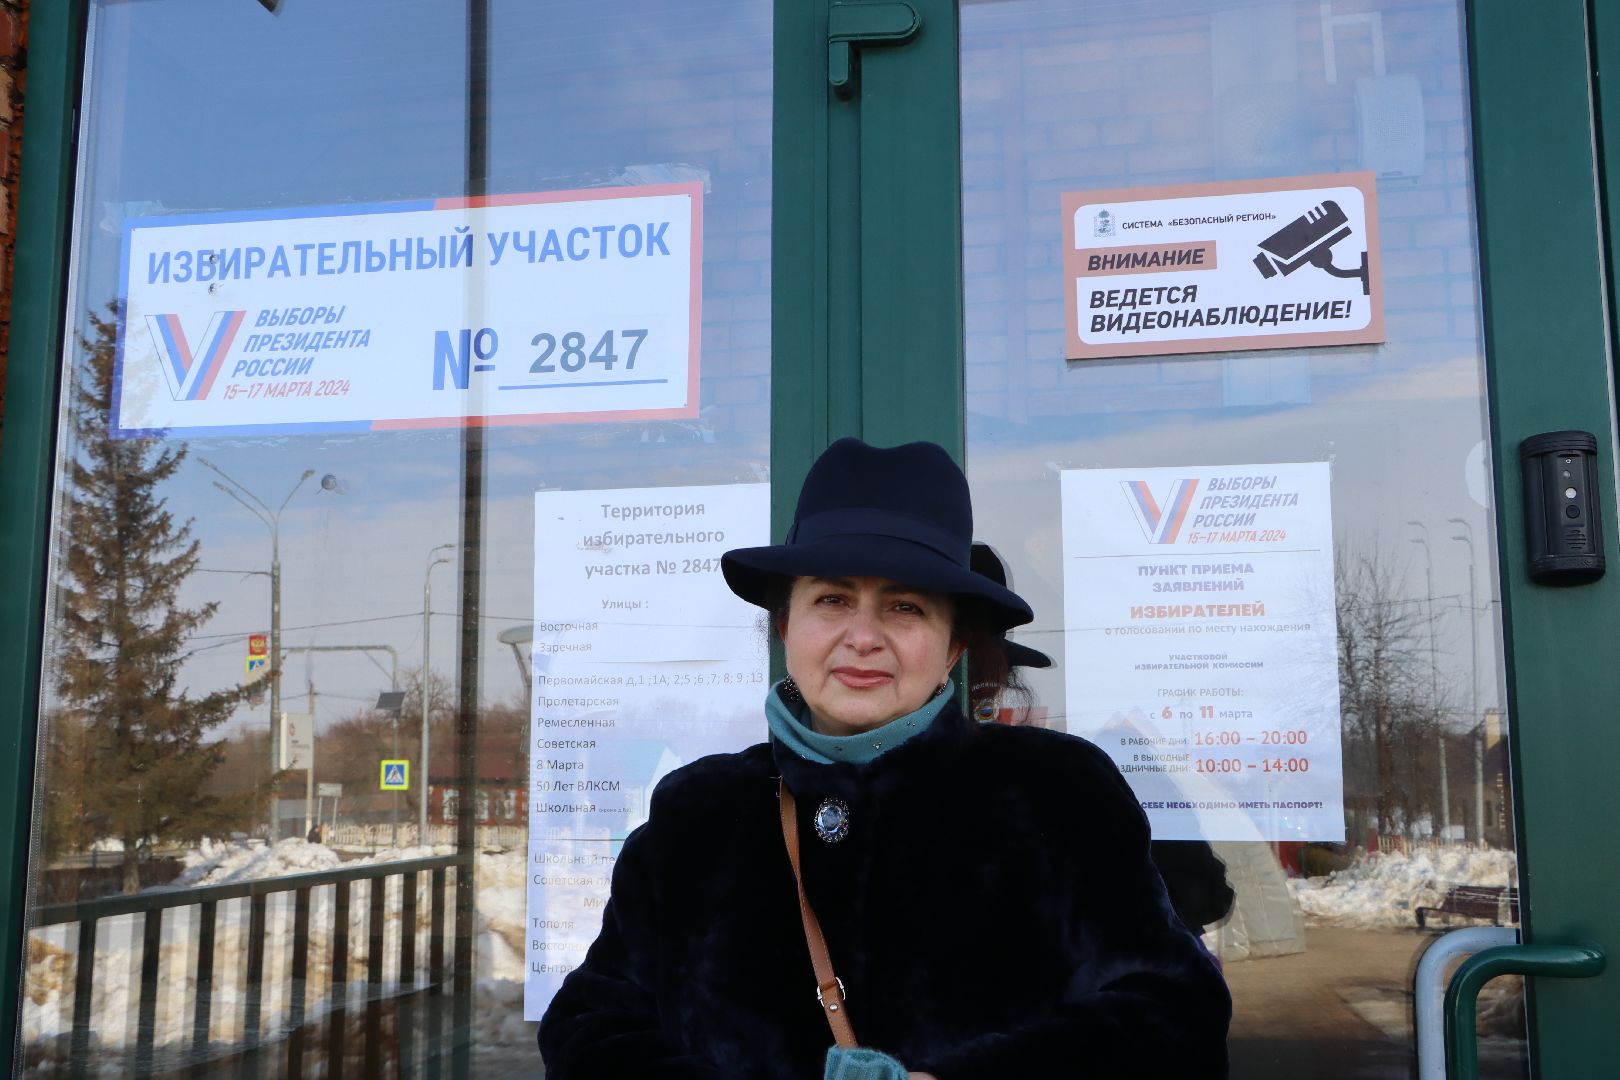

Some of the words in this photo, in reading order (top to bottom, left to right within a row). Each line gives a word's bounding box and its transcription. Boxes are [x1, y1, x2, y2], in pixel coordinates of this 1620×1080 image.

[1122, 219, 1163, 230] СИСТЕМА
[1168, 213, 1233, 227] «БЕЗОПАСНЫЙ
[1236, 212, 1276, 223] РЕГИОН»
[147, 226, 474, 284] ИЗБИРАТЕЛЬНЫЙ
[487, 221, 671, 266] УЧАСТОК
[1087, 248, 1206, 271] ВНИМАНИЕ
[1089, 285, 1198, 311] ВЕДЕТСЯ
[254, 305, 346, 327] ВЫБОРЫ
[1090, 300, 1353, 334] ВИДЕОНАБЛЮДЕНИЕ!
[243, 329, 371, 353] ПРЕЗИДЕНТА
[432, 327, 498, 390] №
[528, 328, 648, 374] 2847
[232, 357, 314, 378] РОССИИ
[266, 381, 312, 398] МАРТА
[314, 379, 351, 396] 2024
[1206, 476, 1277, 491] ВЫБОРЫ
[1199, 493, 1299, 510] ПРЕЗИДЕНТА
[601, 503, 705, 521] Территория
[1193, 513, 1257, 528] РОССИИ
[583, 530, 725, 549] избирательного
[1219, 531, 1256, 543] МАРТА
[1259, 529, 1287, 541] 2024
[585, 564, 650, 579] участка
[656, 560, 677, 574] №
[682, 558, 720, 574] 2847
[1138, 565, 1187, 577] ПУНКТ
[1191, 563, 1255, 575] ПРИЕМА
[1152, 577, 1245, 593] ЗАЯВЛЕНИЙ
[601, 599, 642, 611] Улицы
[1130, 601, 1265, 619] ИЗБИРАТЕЛЕЙ
[540, 621, 598, 632] Восточная
[1114, 626, 1185, 636] голосовании
[1188, 626, 1202, 634] по
[1205, 625, 1237, 635] месту
[1240, 623, 1311, 633] нахождения
[540, 643, 592, 653] Заречная
[1168, 653, 1228, 661] УЧАСТКОВОЙ
[1134, 662, 1209, 670] ИЗБИРАТЕЛЬНОЙ
[1213, 661, 1263, 669] КОМИССИИ
[538, 675, 623, 686] Первомайская
[1157, 688, 1197, 697] ГРАФИК
[1199, 687, 1244, 697] РАБОТЫ:
[538, 696, 619, 707] Пролетарская
[1161, 706, 1172, 719] 6
[1180, 711, 1193, 719] по
[1199, 706, 1214, 719] 11
[1219, 710, 1253, 720] марта
[537, 718, 615, 728] Ремесленная
[537, 739, 596, 749] Советская
[1194, 731, 1240, 745] 16:00
[1261, 730, 1308, 745] 20:00
[1141, 754, 1190, 762] ВЫХОДНЫЕ
[1195, 758, 1242, 773] 10:00
[1262, 757, 1309, 772] 14:00
[537, 760, 543, 770] 8
[547, 760, 584, 771] Марта
[1117, 765, 1167, 773] ЗДНИЧНЫЕ
[537, 781, 550, 791] 50
[553, 781, 574, 791] Лет
[578, 780, 620, 791] ВЛКСМ
[536, 802, 596, 813] Школьная
[1166, 801, 1236, 809] НЕОБХОДИМО
[1238, 801, 1271, 809] ИМЕТЬ
[1272, 801, 1323, 809] ПАСПОРТ!
[601, 856, 616, 864] пе
[533, 918, 574, 929] Тополя
[532, 962, 574, 974] Центра
